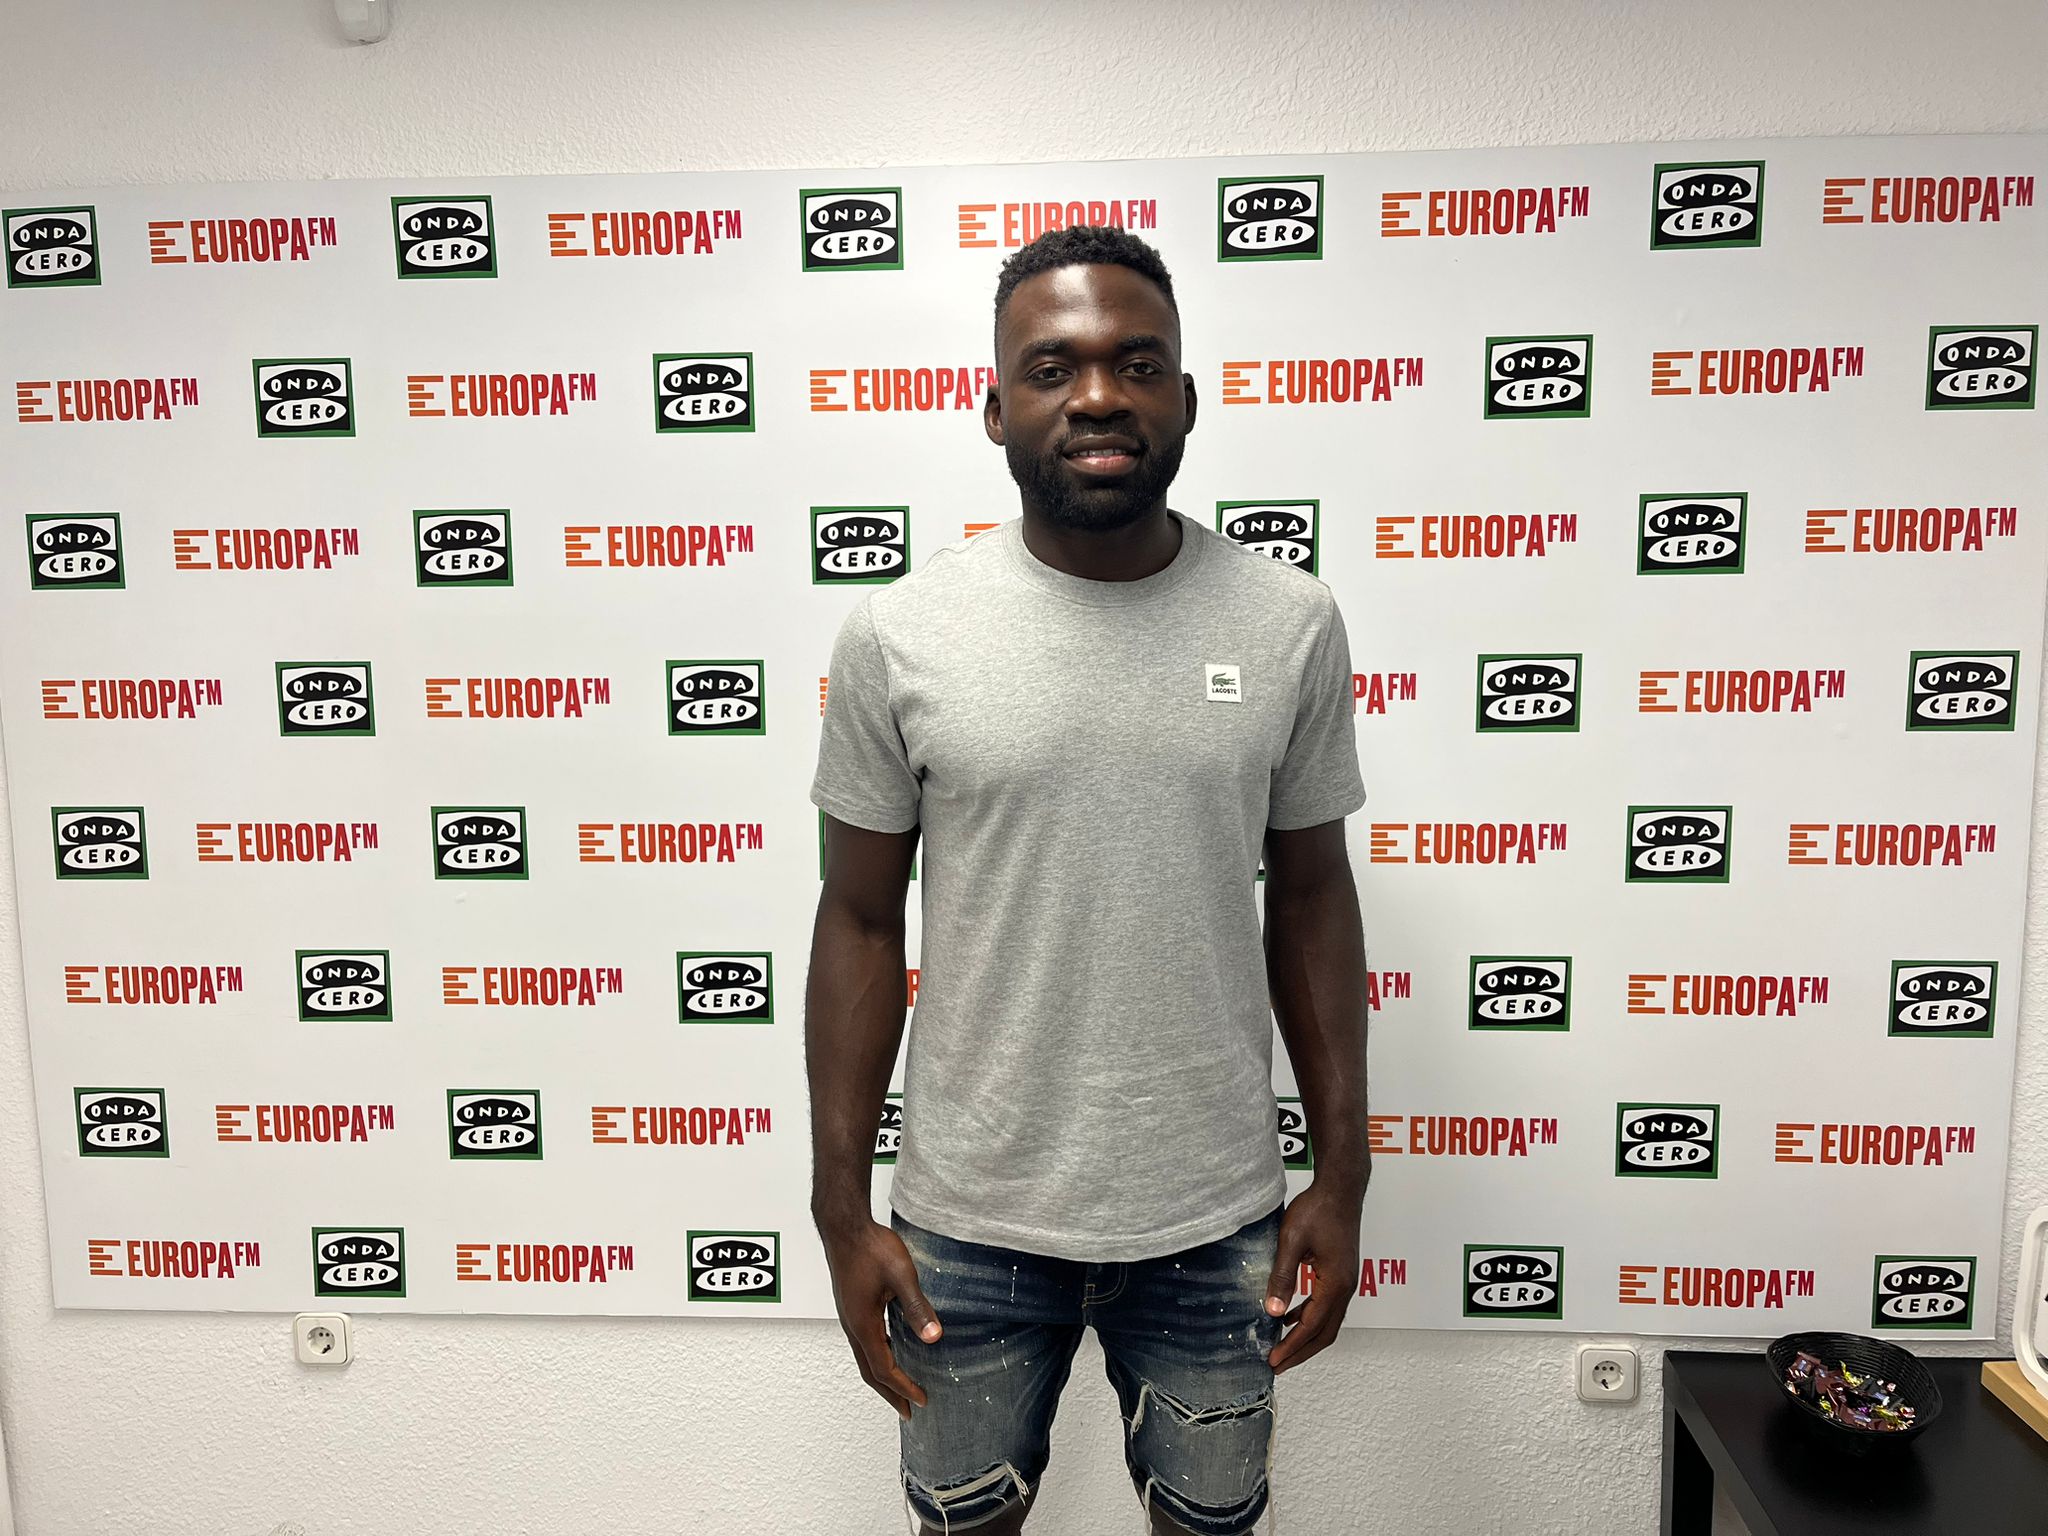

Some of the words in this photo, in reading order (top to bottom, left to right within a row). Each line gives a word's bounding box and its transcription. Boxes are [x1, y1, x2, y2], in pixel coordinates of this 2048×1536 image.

[1672, 183, 1742, 200] ONDA
[1236, 197, 1303, 213] ONDA
[818, 208, 883, 224] ONDA
[1674, 212, 1741, 230] CERO
[411, 216, 475, 232] ONDA
[20, 226, 80, 242] ONDA
[1239, 225, 1303, 243] CERO
[822, 236, 884, 253] CERO
[417, 244, 477, 261] CERO
[25, 253, 82, 270] CERO
[1947, 346, 2016, 361] ONDA
[1503, 356, 1572, 372] ONDA
[271, 378, 334, 392] ONDA
[671, 372, 735, 387] ONDA
[1949, 374, 2016, 391] CERO
[1506, 383, 1571, 401] CERO
[276, 404, 336, 420] CERO
[675, 399, 736, 415] CERO
[1233, 520, 1299, 535] ONDA
[1657, 513, 1726, 528] ONDA
[43, 532, 104, 546] ONDA
[431, 529, 493, 543] ONDA
[828, 526, 891, 540] ONDA
[1660, 540, 1725, 557] CERO
[49, 557, 106, 573] CERO
[436, 554, 494, 570] CERO
[832, 551, 892, 567] CERO
[683, 678, 746, 692] ONDA
[1495, 673, 1561, 687] ONDA
[1928, 670, 1997, 685] ONDA
[293, 680, 354, 694] ONDA
[1211, 687, 1238, 695] LACOSTE
[299, 705, 356, 720] CERO
[688, 703, 747, 719] CERO
[1498, 699, 1561, 715] CERO
[1929, 697, 1996, 714] CERO
[69, 824, 128, 838] ONDA
[448, 824, 509, 838] ONDA
[1645, 825, 1711, 838] ONDA
[74, 849, 130, 864] CERO
[453, 849, 510, 864] CERO
[1647, 850, 1711, 866] CERO
[313, 967, 372, 980] ONDA
[694, 969, 754, 982] ONDA
[1487, 974, 1552, 988] ONDA
[1909, 979, 1976, 993] ONDA
[317, 991, 374, 1006] CERO
[698, 993, 755, 1008] CERO
[1490, 999, 1551, 1014] CERO
[1911, 1005, 1975, 1020] CERO
[91, 1105, 149, 1117] ONDA
[464, 1106, 523, 1119] ONDA
[96, 1128, 151, 1142] CERO
[1634, 1121, 1699, 1134] ONDA
[468, 1130, 524, 1144] CERO
[1637, 1146, 1699, 1161] CERO
[329, 1244, 387, 1257] ONDA
[703, 1248, 763, 1261] ONDA
[333, 1267, 388, 1281] CERO
[1480, 1263, 1544, 1275] ONDA
[707, 1272, 763, 1286] CERO
[1891, 1274, 1956, 1287] ONDA
[1484, 1287, 1544, 1302] CERO
[1893, 1298, 1954, 1313] CERO
